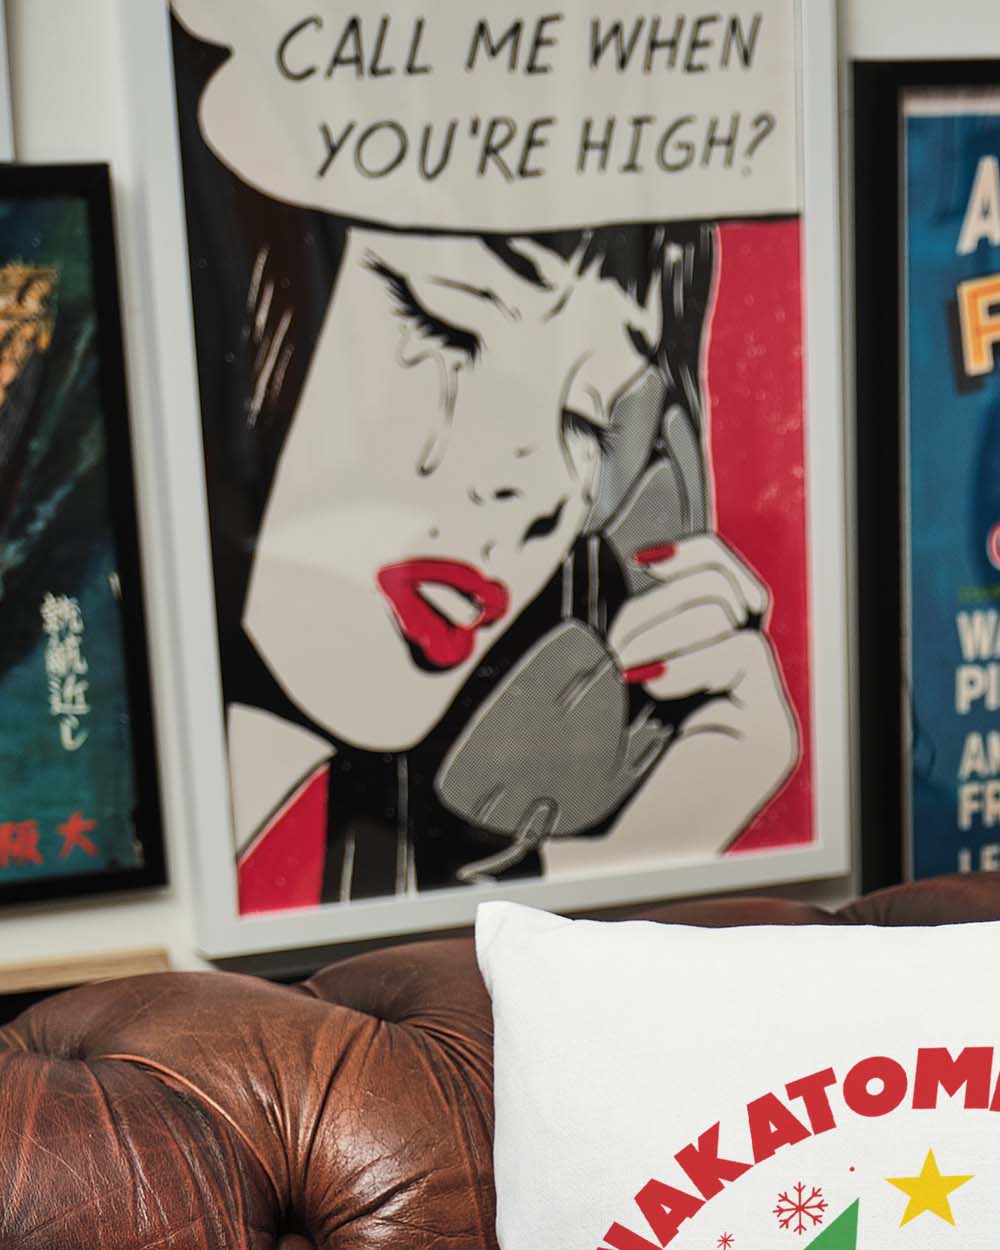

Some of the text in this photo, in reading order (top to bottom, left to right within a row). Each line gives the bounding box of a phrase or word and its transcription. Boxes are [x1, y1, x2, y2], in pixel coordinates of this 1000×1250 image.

[276, 14, 761, 82] CALL ME WHEN
[317, 113, 776, 181] YOU'RE HIGH?
